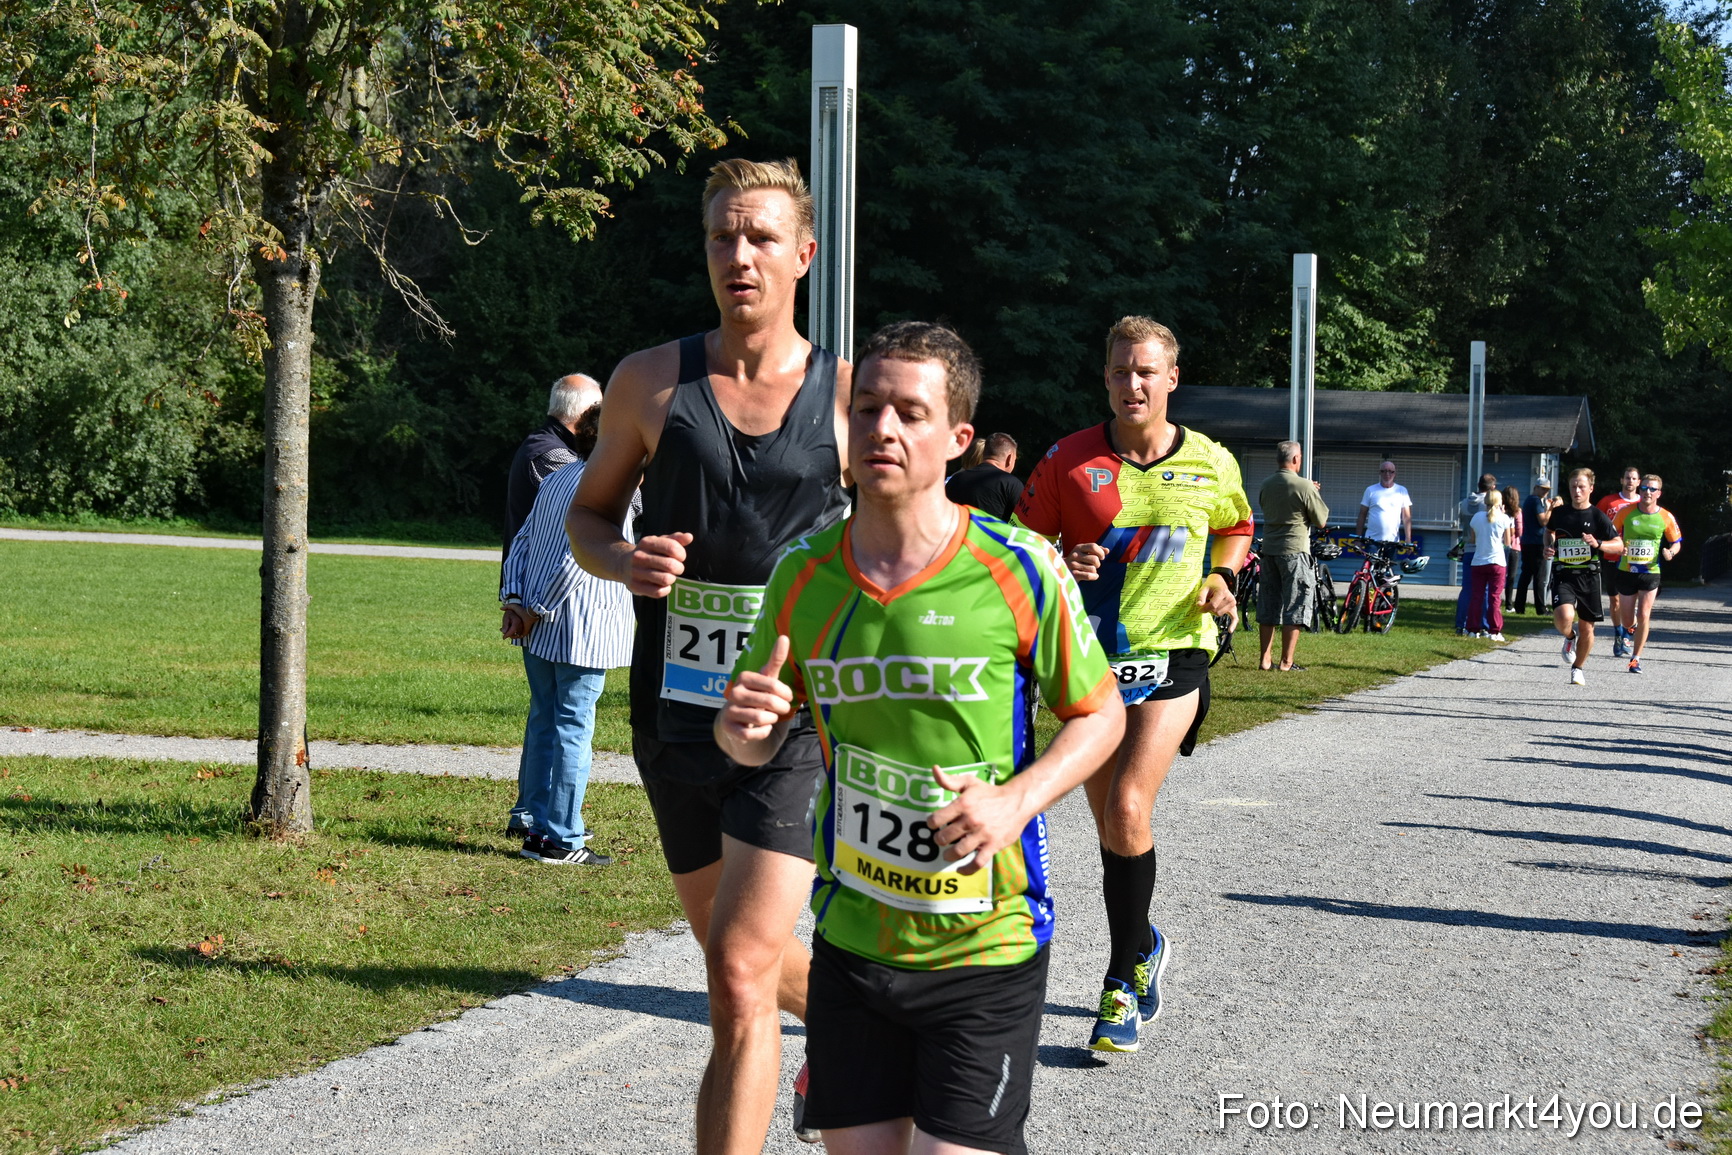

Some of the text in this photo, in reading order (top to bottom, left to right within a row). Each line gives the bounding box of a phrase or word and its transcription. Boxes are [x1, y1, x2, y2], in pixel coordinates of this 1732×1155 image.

[1562, 548, 1587, 556] 1132
[1631, 548, 1651, 556] 1282
[675, 583, 765, 618] BOC
[702, 675, 728, 694] JÖ
[804, 655, 990, 704] BOCK
[1122, 682, 1156, 701] MAS
[847, 751, 979, 808] BOC
[853, 803, 940, 863] 128
[857, 857, 958, 896] MARKUS
